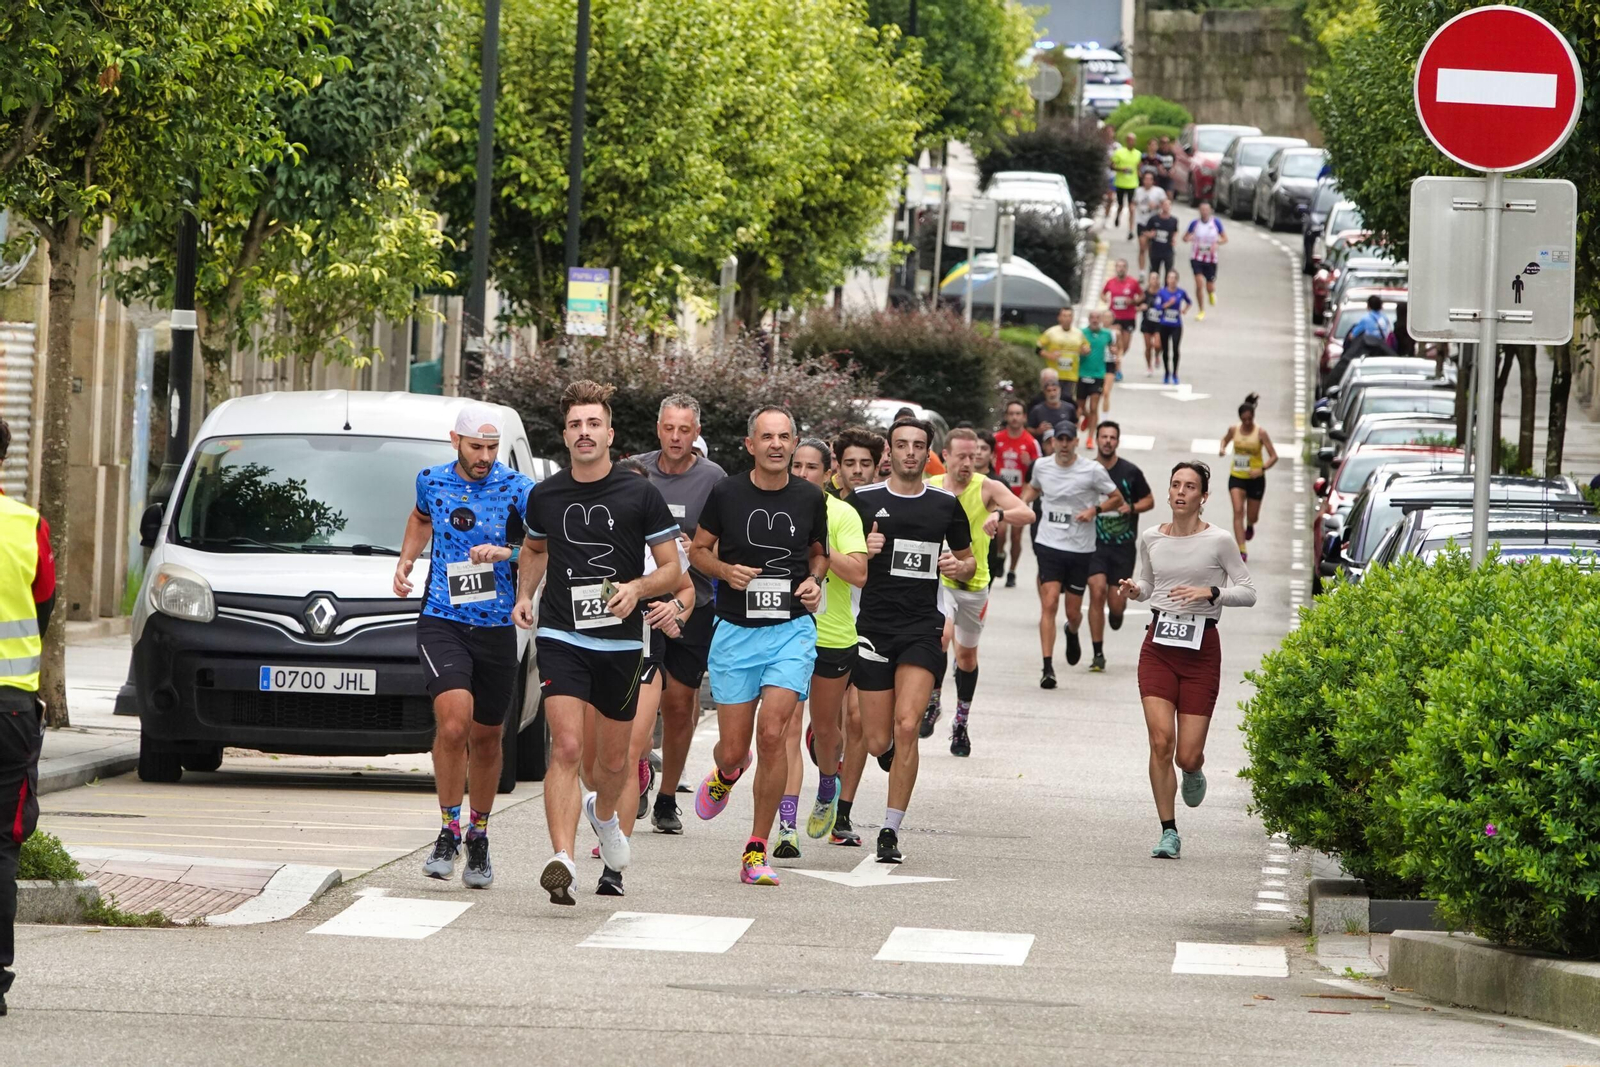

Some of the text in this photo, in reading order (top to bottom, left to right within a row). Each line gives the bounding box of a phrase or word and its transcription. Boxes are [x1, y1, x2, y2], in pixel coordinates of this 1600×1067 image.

[903, 552, 922, 568] 43
[458, 573, 482, 592] 211
[755, 591, 782, 607] 185
[1160, 622, 1188, 637] 258
[275, 671, 370, 691] 0700 JHL
